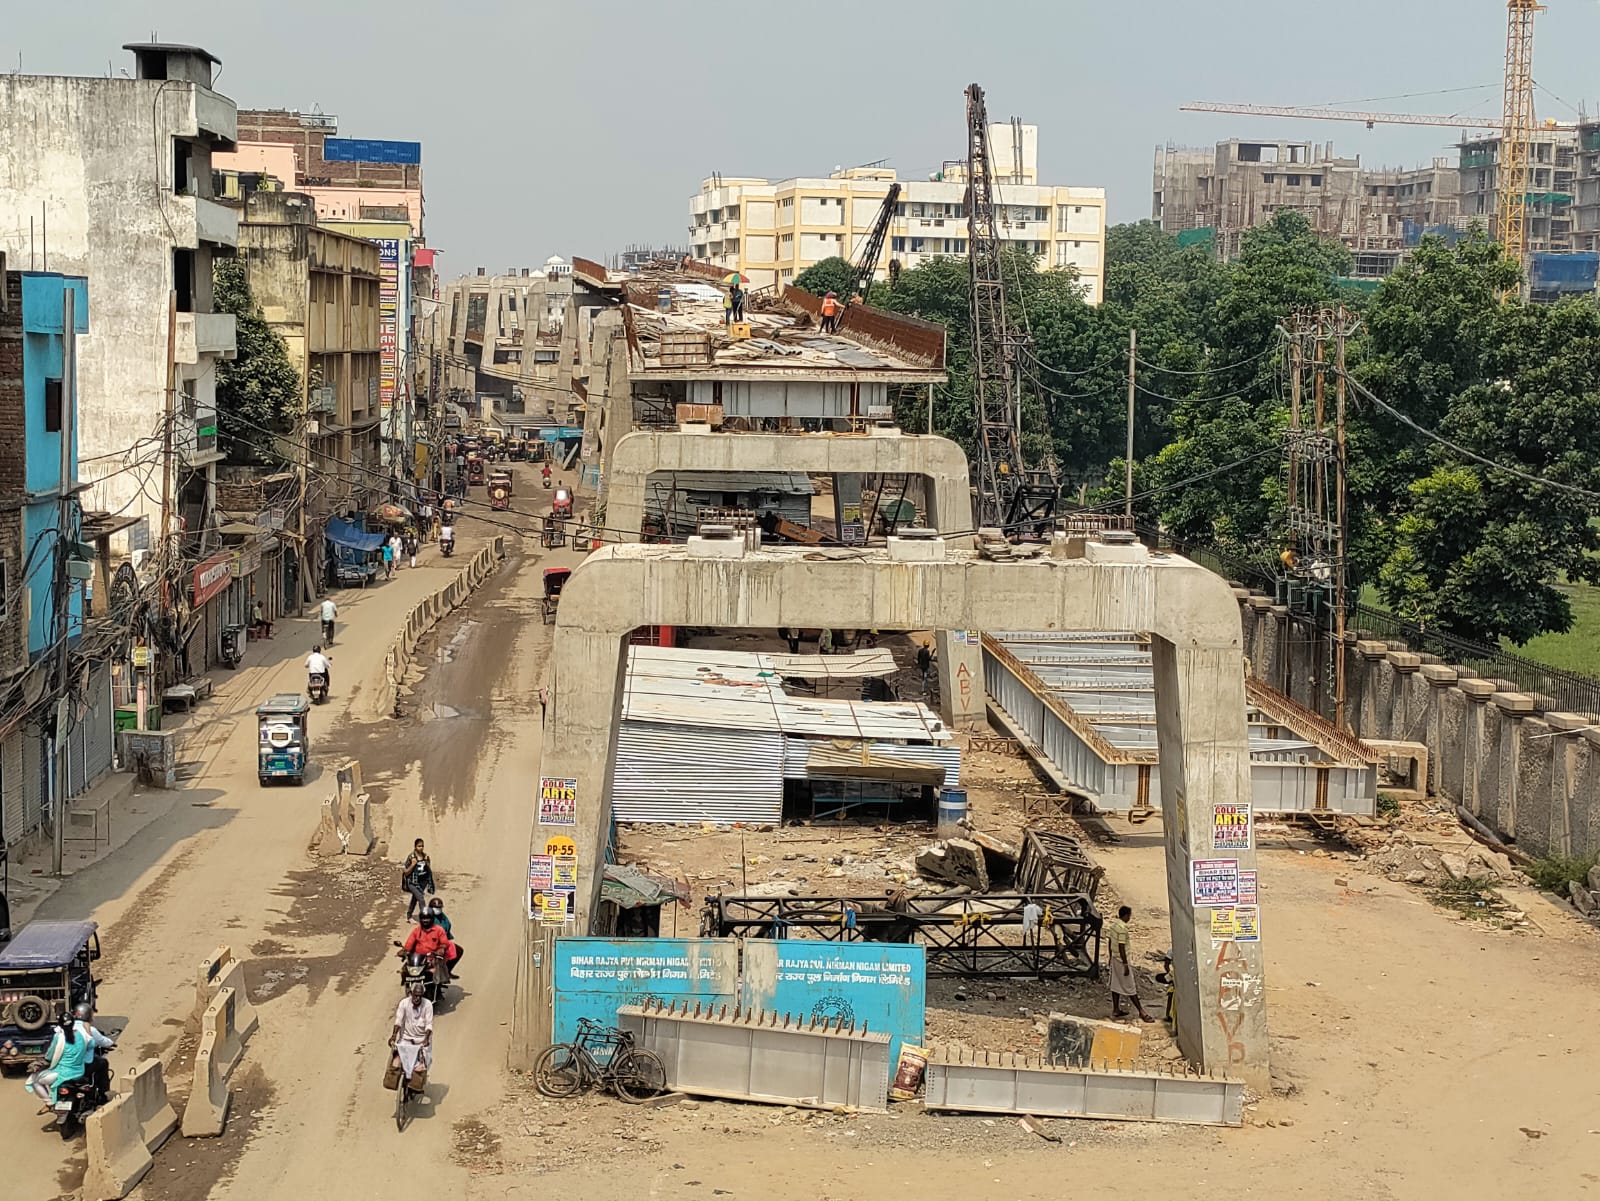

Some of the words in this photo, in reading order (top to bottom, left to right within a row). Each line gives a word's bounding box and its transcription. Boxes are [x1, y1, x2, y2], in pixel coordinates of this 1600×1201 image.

[542, 788, 575, 800] ARTS
[1215, 814, 1248, 825] ARTS
[547, 844, 575, 856] PP-55
[571, 956, 594, 966] BIHAR
[666, 957, 689, 967] NIGA
[785, 959, 809, 969] RAJYA
[881, 962, 912, 972] LIMITED
[570, 966, 594, 979] बिहार
[851, 972, 877, 984] निगम
